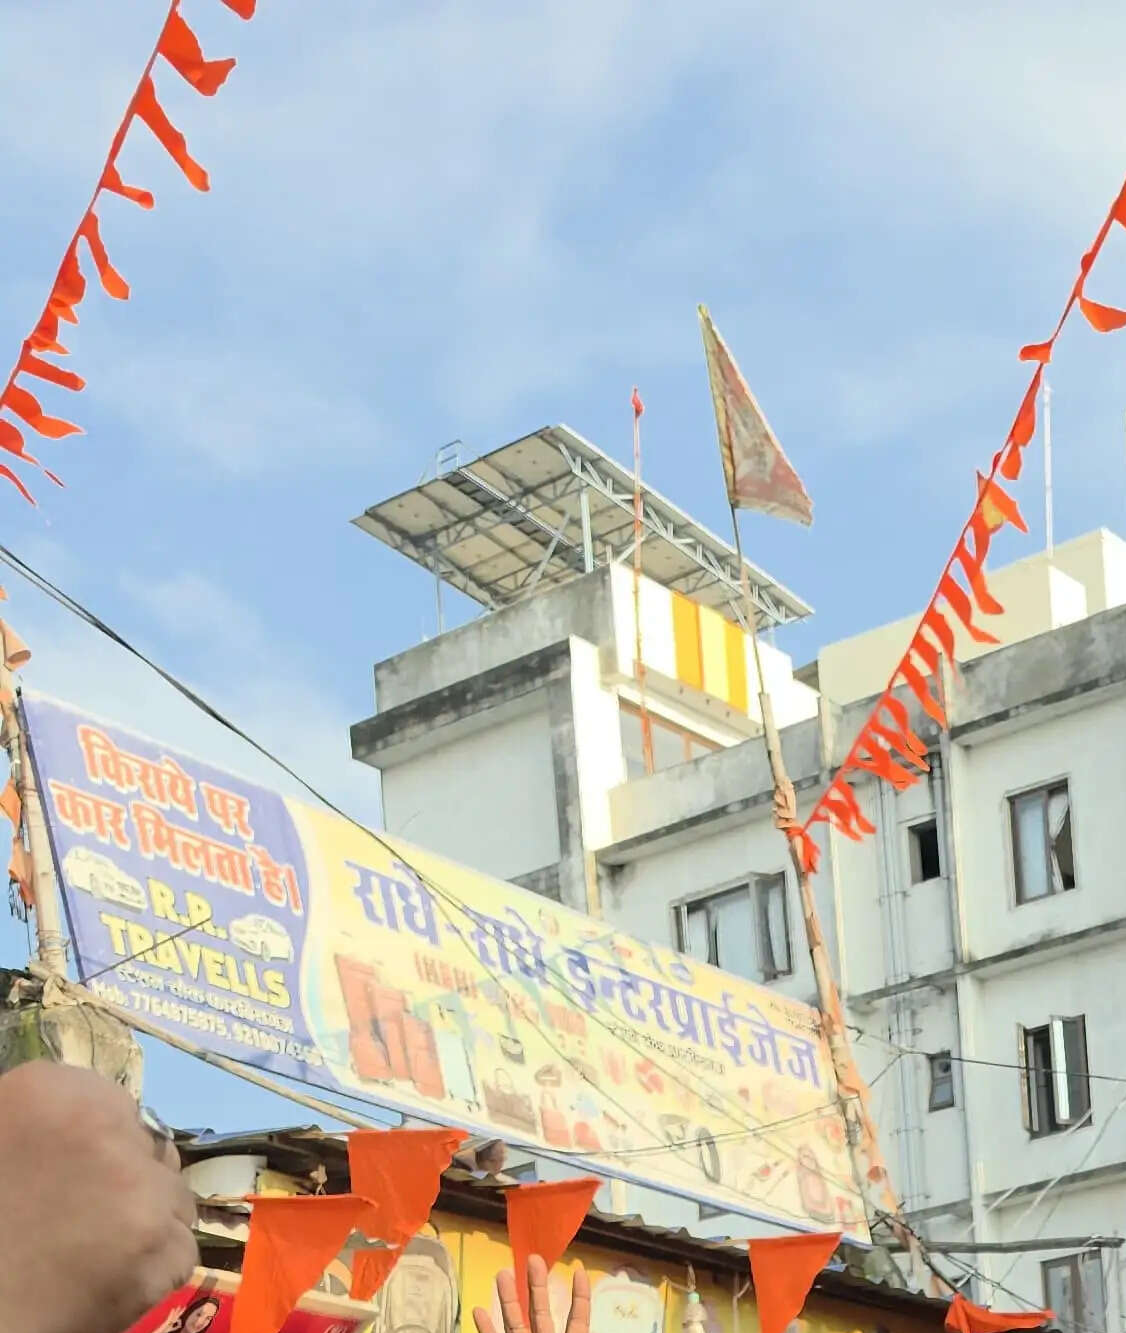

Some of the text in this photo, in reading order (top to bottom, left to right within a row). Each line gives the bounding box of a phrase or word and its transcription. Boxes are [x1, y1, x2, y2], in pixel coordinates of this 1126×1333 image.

[48, 779, 130, 851] कार
[129, 800, 255, 895] मिलता
[77, 724, 254, 840] किराये पर
[98, 911, 291, 1009] TRAVELLS
